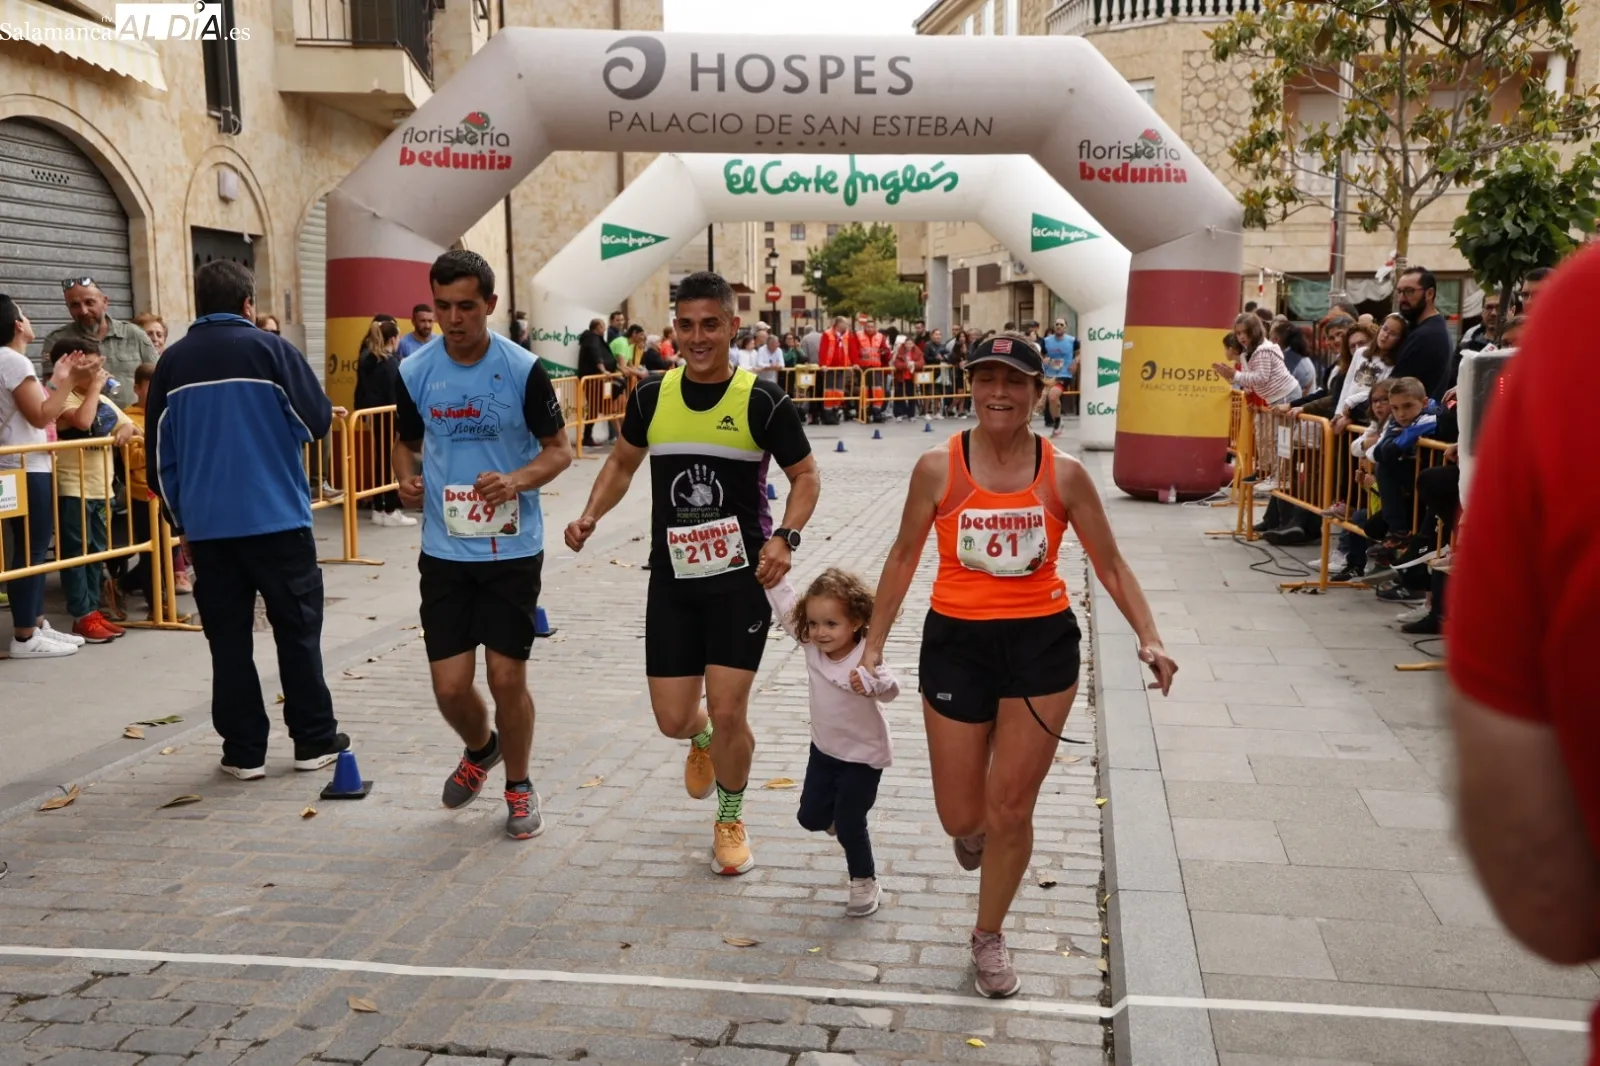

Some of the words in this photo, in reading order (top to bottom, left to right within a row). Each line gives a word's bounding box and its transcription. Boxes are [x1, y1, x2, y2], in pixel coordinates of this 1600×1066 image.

[689, 52, 914, 96] HOSPES
[608, 110, 743, 135] PALACIO
[755, 113, 793, 135] DE
[802, 114, 861, 136] SAN
[872, 115, 994, 137] ESTEBAN
[399, 146, 512, 170] bedunia
[724, 159, 758, 195] El
[760, 160, 839, 195] Corte
[843, 154, 959, 207] Inglés
[1079, 161, 1188, 184] bedunia
[1088, 327, 1097, 341] El
[1161, 367, 1220, 382] HOSPES
[1087, 402, 1096, 415] El
[467, 503, 495, 522] 49
[960, 511, 1043, 531] bedunia
[669, 522, 739, 545] bedunia
[986, 533, 1018, 557] 61
[685, 539, 728, 564] 218
